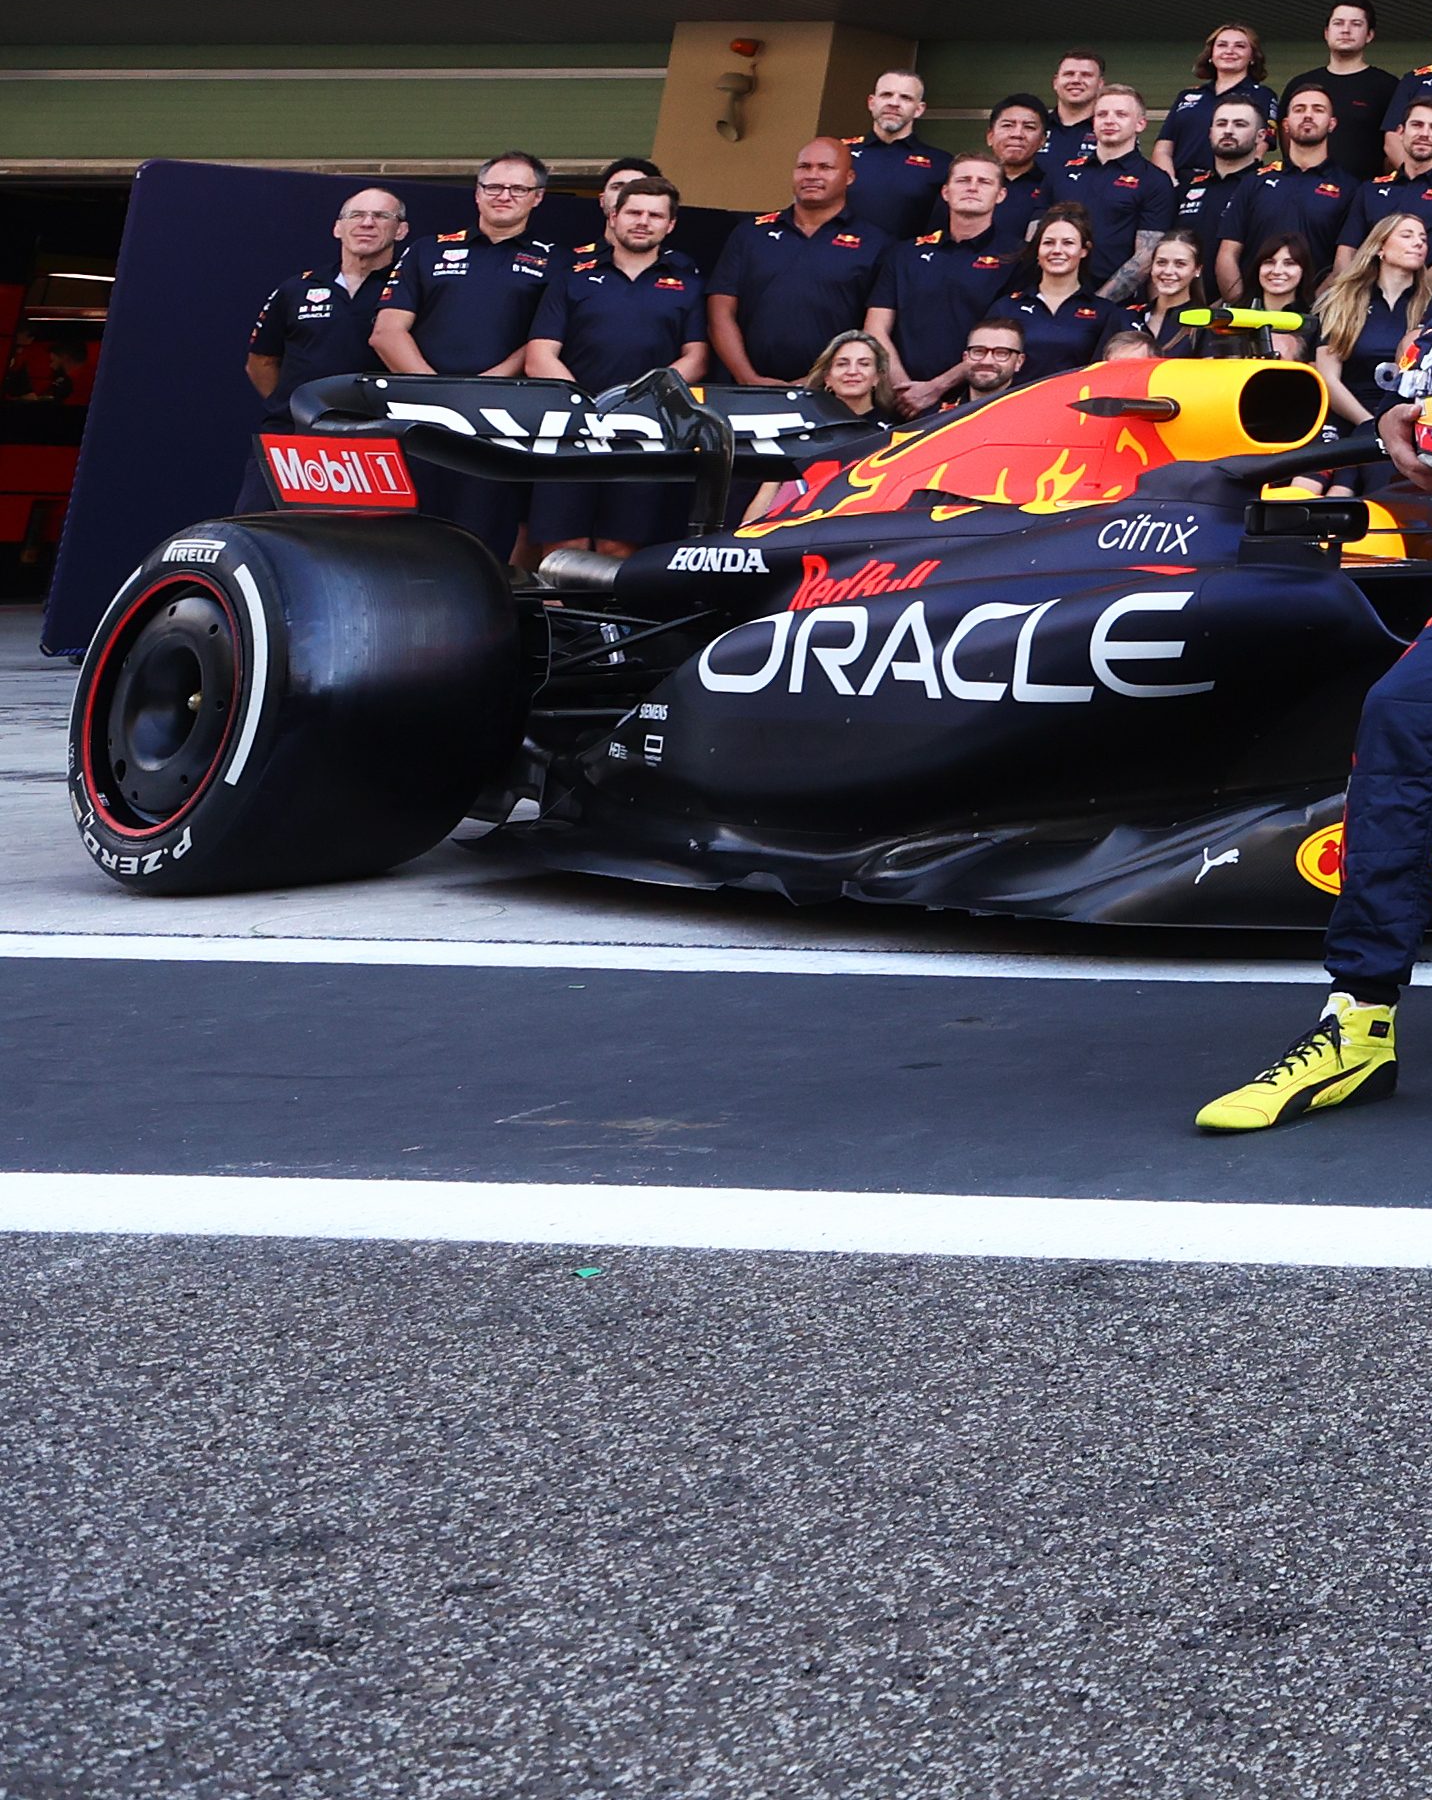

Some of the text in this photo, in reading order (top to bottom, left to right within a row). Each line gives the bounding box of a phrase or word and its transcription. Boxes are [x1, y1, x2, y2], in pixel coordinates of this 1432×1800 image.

[270, 447, 371, 494] Mobil
[162, 539, 226, 563] PIRELLI
[1098, 514, 1198, 555] citrix
[667, 547, 770, 574] HONDA
[699, 591, 1216, 703] ORACLE
